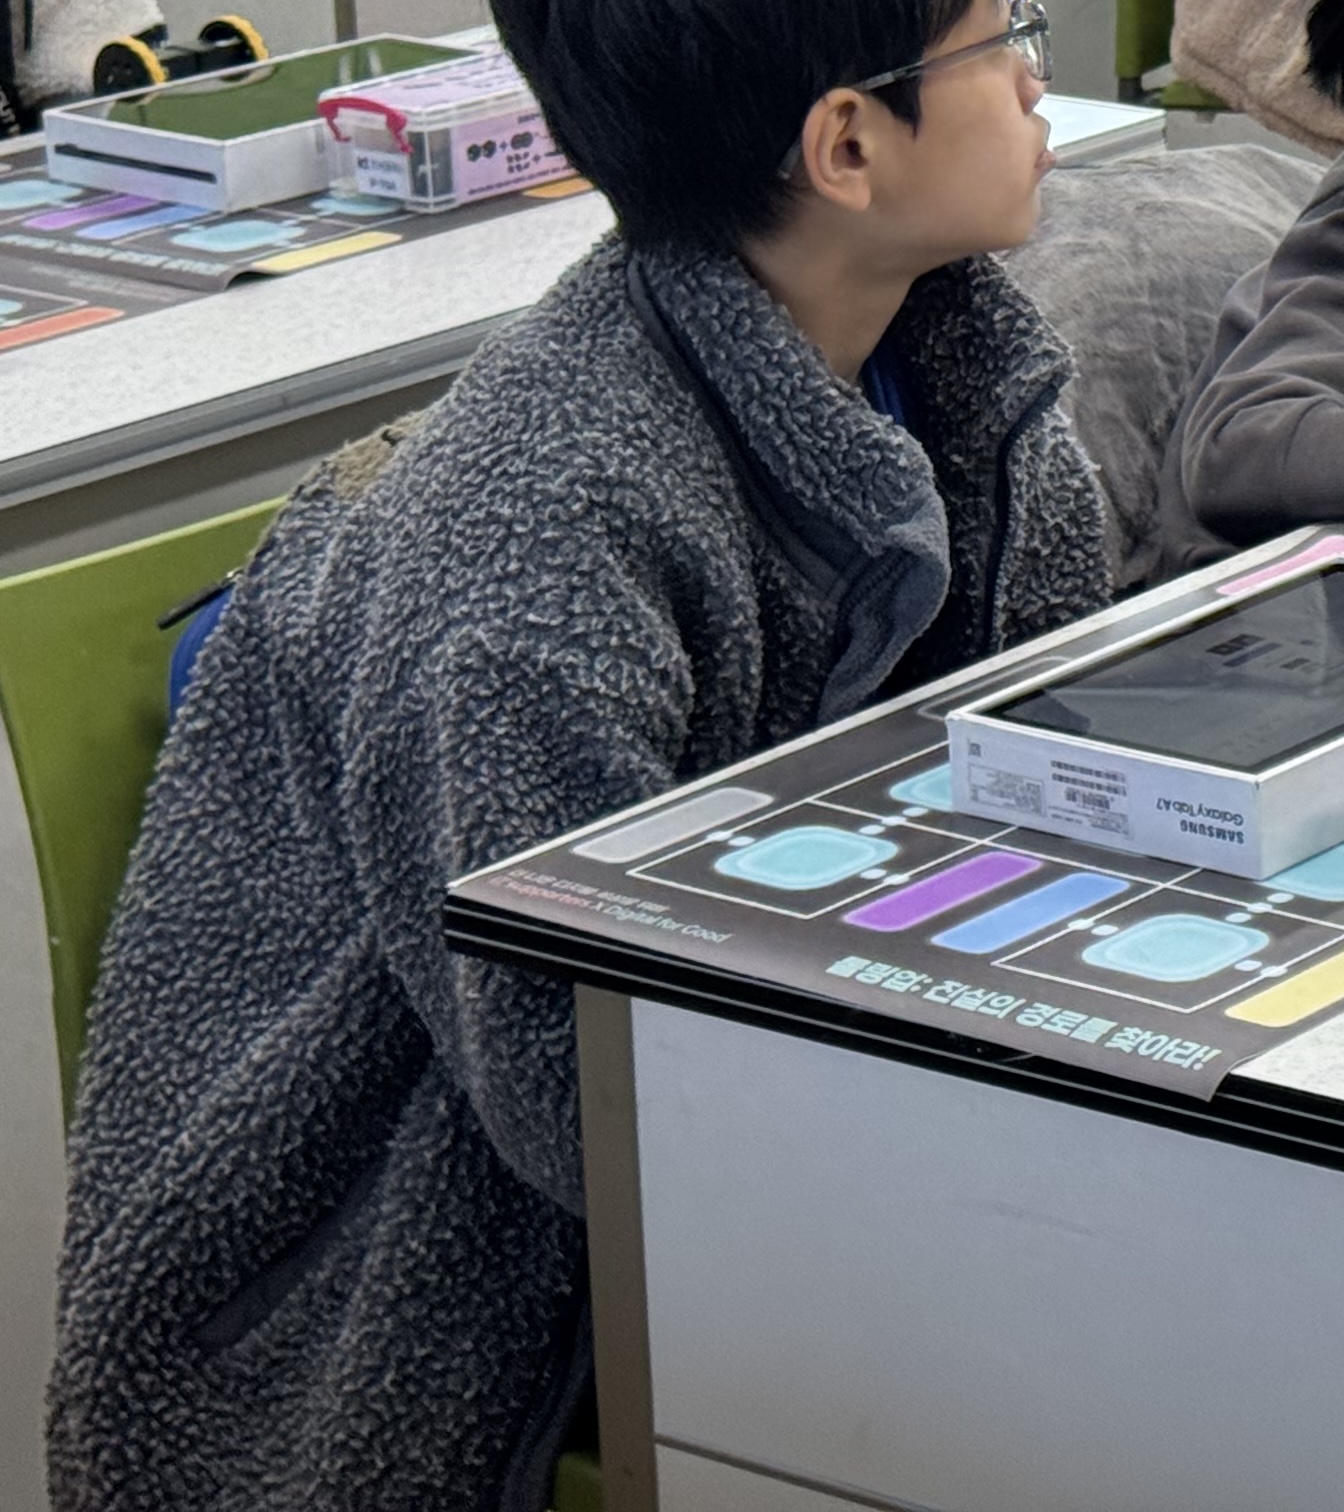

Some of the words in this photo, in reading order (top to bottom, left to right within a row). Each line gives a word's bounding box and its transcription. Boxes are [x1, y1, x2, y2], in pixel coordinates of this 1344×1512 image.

[1199, 804, 1244, 826] Galaxy
[1180, 820, 1244, 844] SAMSUNG
[602, 903, 661, 928] Digital
[658, 915, 683, 930] for
[681, 923, 735, 944] Good
[922, 979, 1028, 1019] 진실의
[1016, 1002, 1118, 1044] 경로를
[1104, 1026, 1222, 1072] 찾아라!
